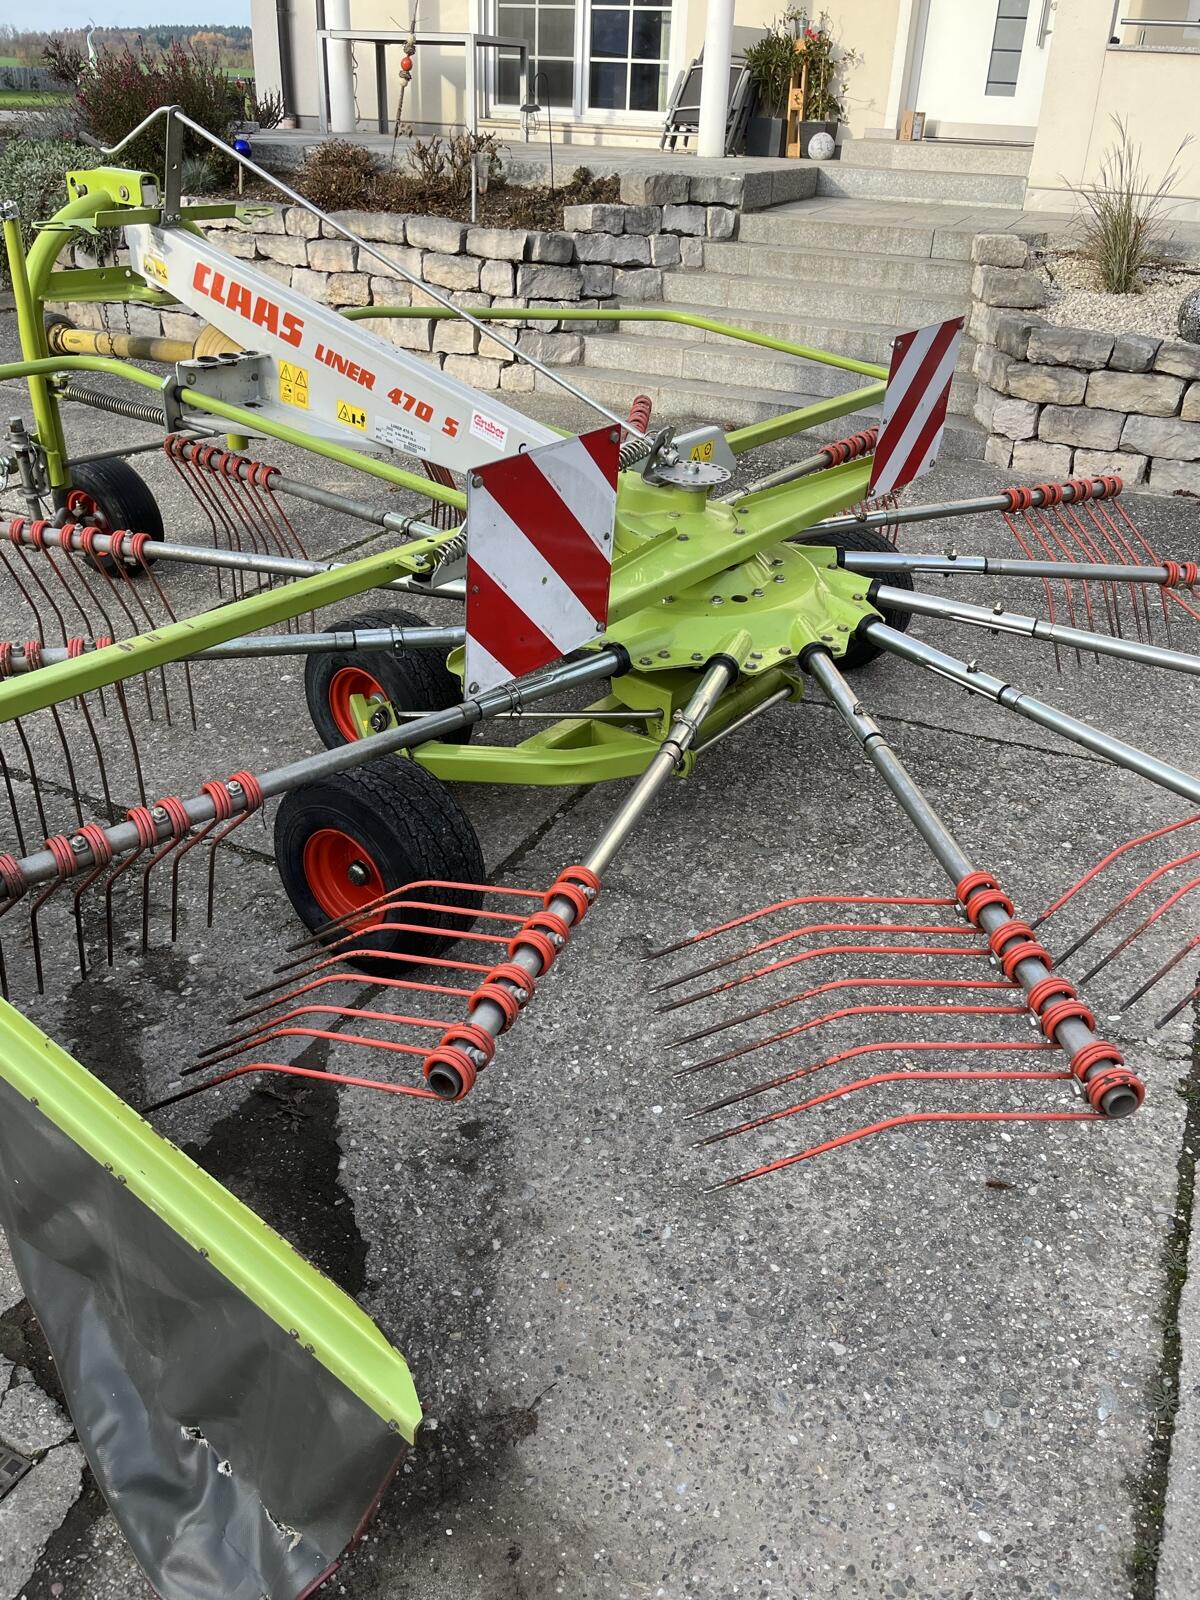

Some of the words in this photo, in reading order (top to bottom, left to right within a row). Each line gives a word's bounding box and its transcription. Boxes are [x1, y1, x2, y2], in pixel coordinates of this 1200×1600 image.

[193, 262, 304, 348] CLAAS
[314, 344, 376, 391] LINER
[387, 387, 434, 422] 470
[441, 416, 459, 438] S
[473, 414, 505, 439] Gruber
